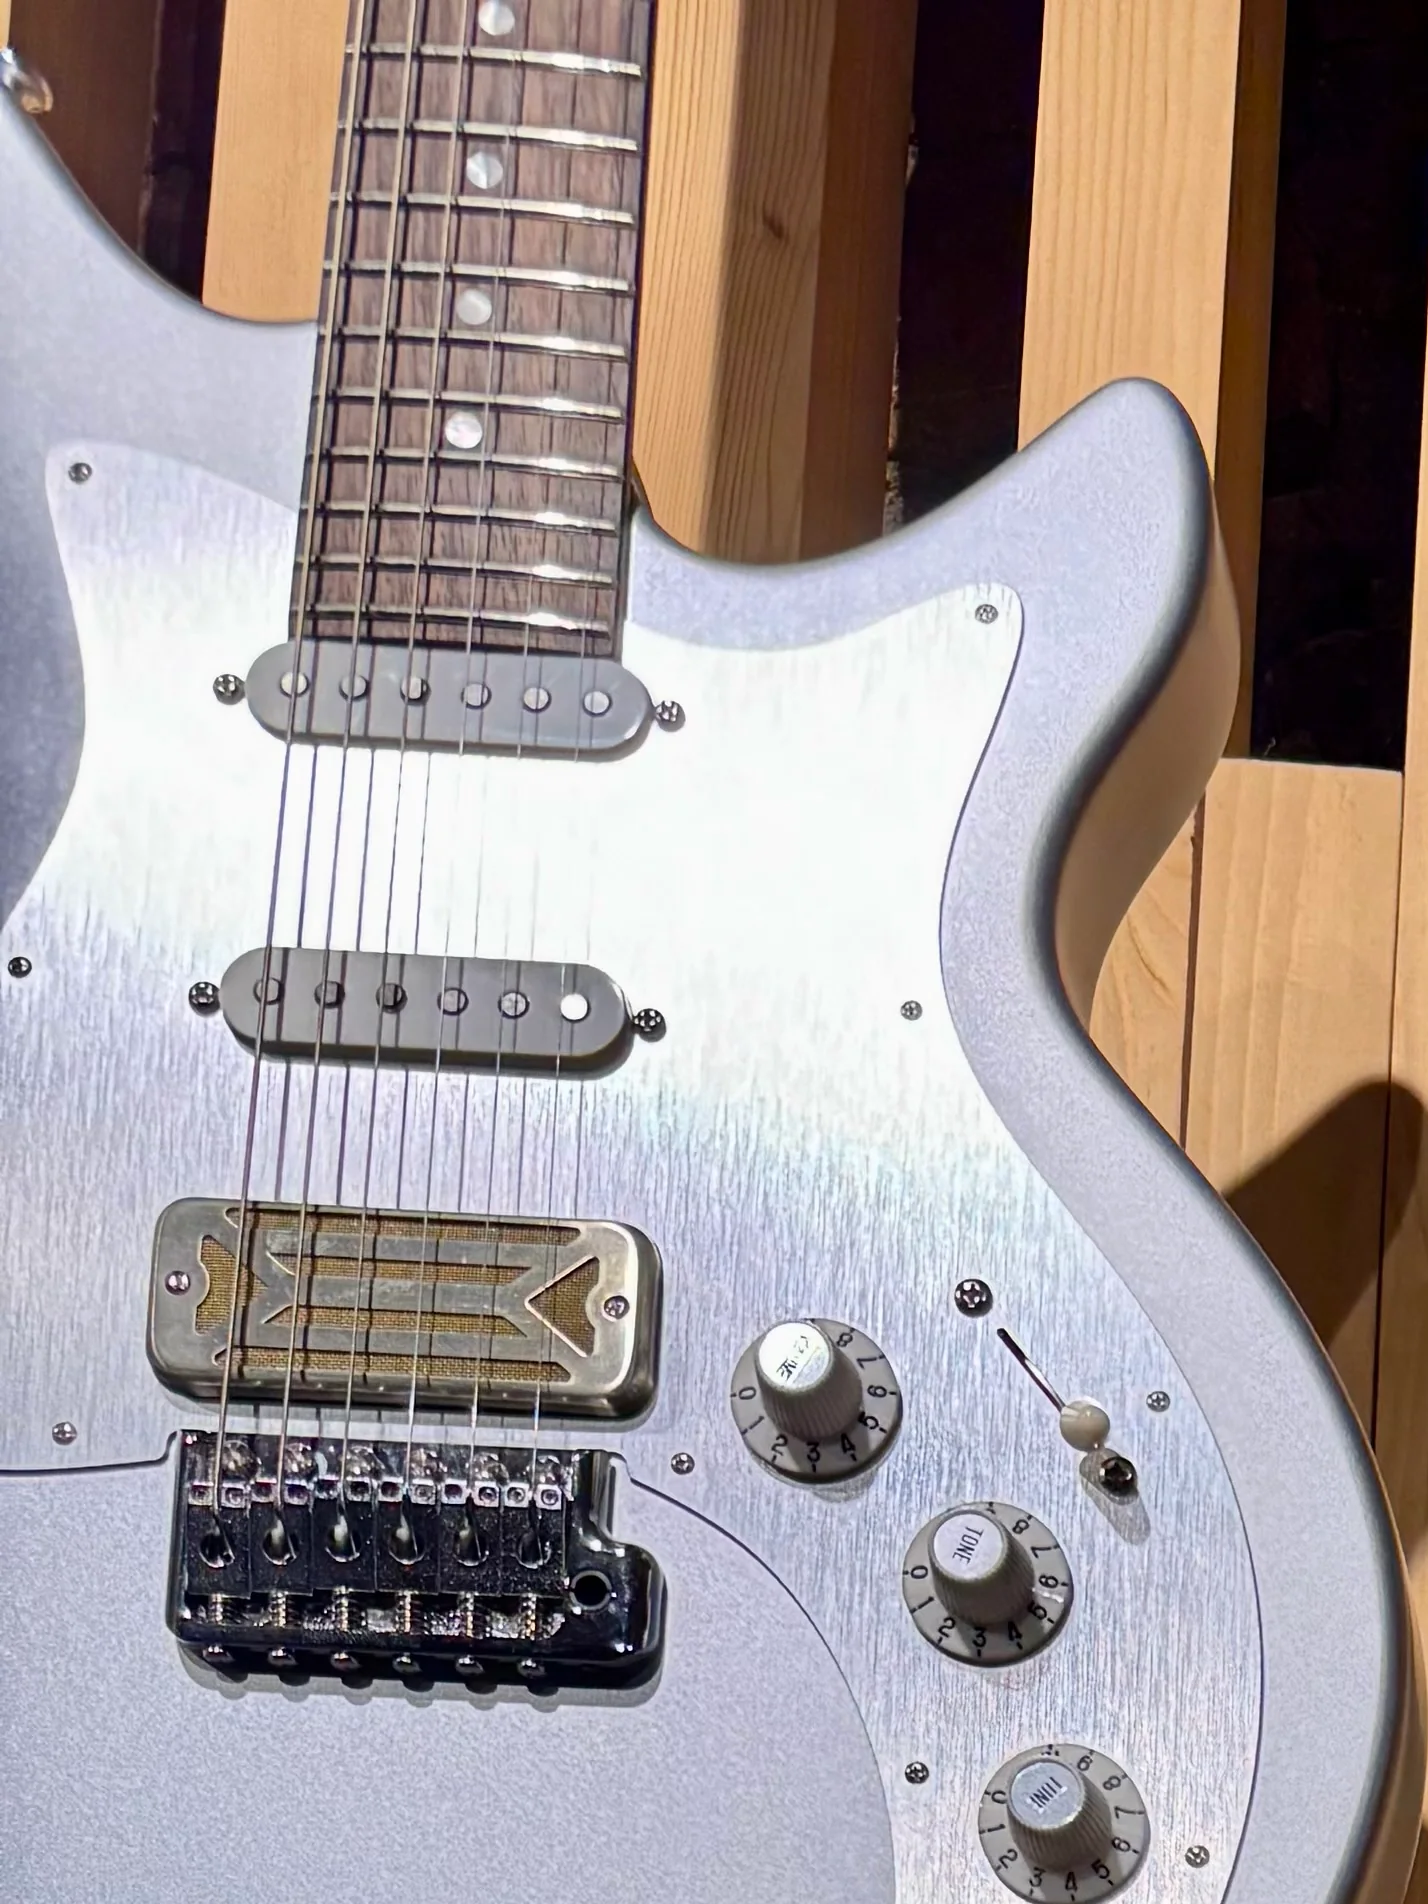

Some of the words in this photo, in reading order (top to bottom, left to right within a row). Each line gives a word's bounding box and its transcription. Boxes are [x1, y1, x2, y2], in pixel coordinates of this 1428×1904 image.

[836, 1332, 854, 1347] 8
[856, 1356, 878, 1370] 7
[739, 1386, 757, 1401] 0
[867, 1384, 888, 1398] 6
[749, 1415, 765, 1430] 1
[858, 1411, 880, 1430] 5
[771, 1433, 788, 1457] 2
[840, 1433, 857, 1454] 4
[806, 1441, 821, 1463] 3
[1012, 1518, 1030, 1534] 8
[952, 1526, 985, 1565] TONE
[1030, 1546, 1053, 1559] 7
[910, 1565, 929, 1580] 0
[1038, 1574, 1059, 1589] 6
[917, 1596, 935, 1610] 1
[1027, 1601, 1047, 1620] 5
[937, 1617, 956, 1638] 2
[1007, 1621, 1023, 1642] 4
[972, 1626, 987, 1648] 3
[1102, 1775, 1122, 1791] 8
[1114, 1806, 1136, 1819] 7
[987, 1823, 1006, 1833] 1
[1111, 1836, 1131, 1852] 6
[999, 1848, 1018, 1869] 2
[1029, 1866, 1047, 1887] 3
[1091, 1858, 1111, 1879] 5
[1064, 1871, 1078, 1892] 4
